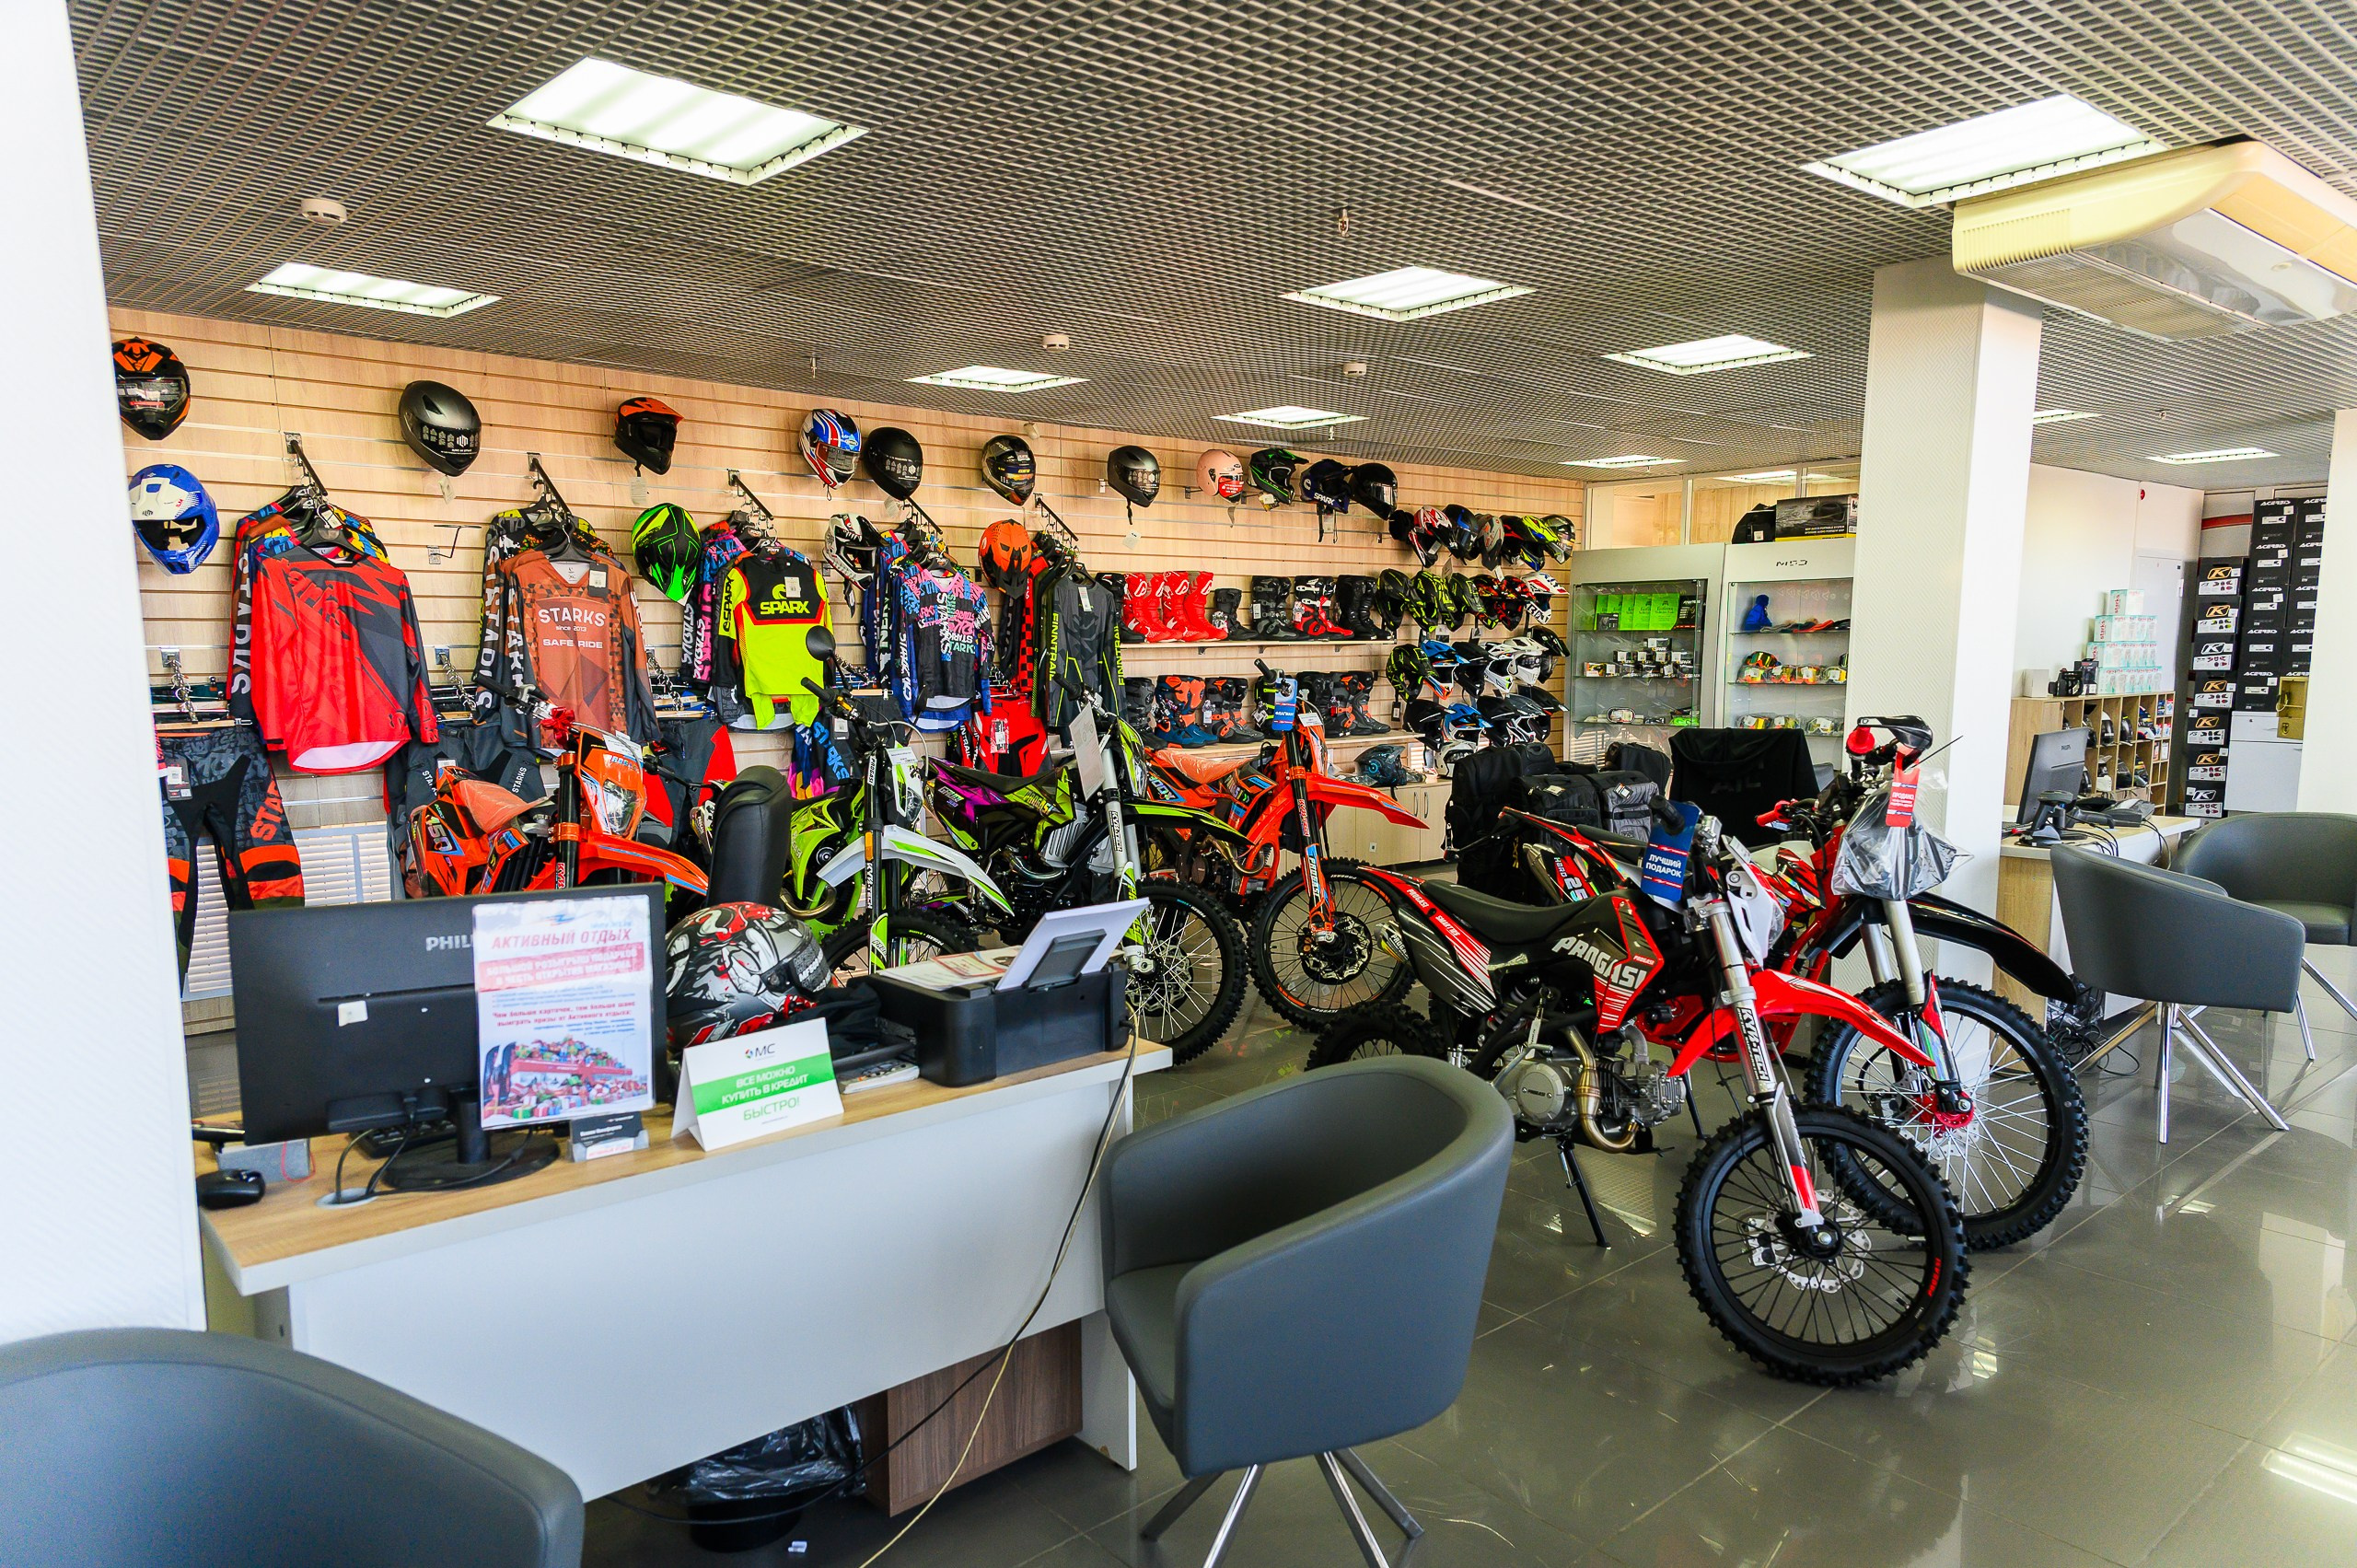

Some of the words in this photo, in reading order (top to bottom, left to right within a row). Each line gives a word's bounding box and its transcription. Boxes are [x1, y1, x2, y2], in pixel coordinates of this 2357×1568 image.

[1314, 493, 1335, 505] SPARK
[761, 600, 810, 614] SPARX
[539, 607, 607, 627] STARKS
[542, 638, 574, 647] SAFE
[577, 639, 603, 649] RIDE
[512, 765, 528, 794] STARKS
[867, 757, 876, 784] PROGASI
[1645, 862, 1682, 877] ПОДАРОК
[1649, 854, 1682, 868] ЛУЧШИЙ
[1407, 889, 1430, 908] PROGASI
[492, 933, 575, 949] АКТИВНЫЙ
[580, 928, 632, 945] ОТДЫХ
[486, 961, 533, 977] БОЛЬШОЙ
[535, 955, 589, 970] РОЗЫГРЫШ
[592, 948, 637, 963] ПОДАРКОВ
[1551, 936, 1647, 989] PROGASI
[505, 972, 534, 984] ЧЕСТЬ
[536, 967, 584, 981] ОТКРЫТИЯ
[510, 1008, 537, 1017] больше
[590, 1002, 615, 1010] больше
[497, 1016, 531, 1027] выиграть
[534, 1015, 556, 1024] призы
[568, 1012, 603, 1022] Активного
[737, 1075, 756, 1088] ВСЕ
[756, 1065, 795, 1084] МОЖНО
[721, 1088, 762, 1104] КУПИТЬ
[762, 1084, 770, 1094] В
[771, 1074, 809, 1092] КРЕДИТ
[743, 1097, 800, 1121] БЫСТРО!
